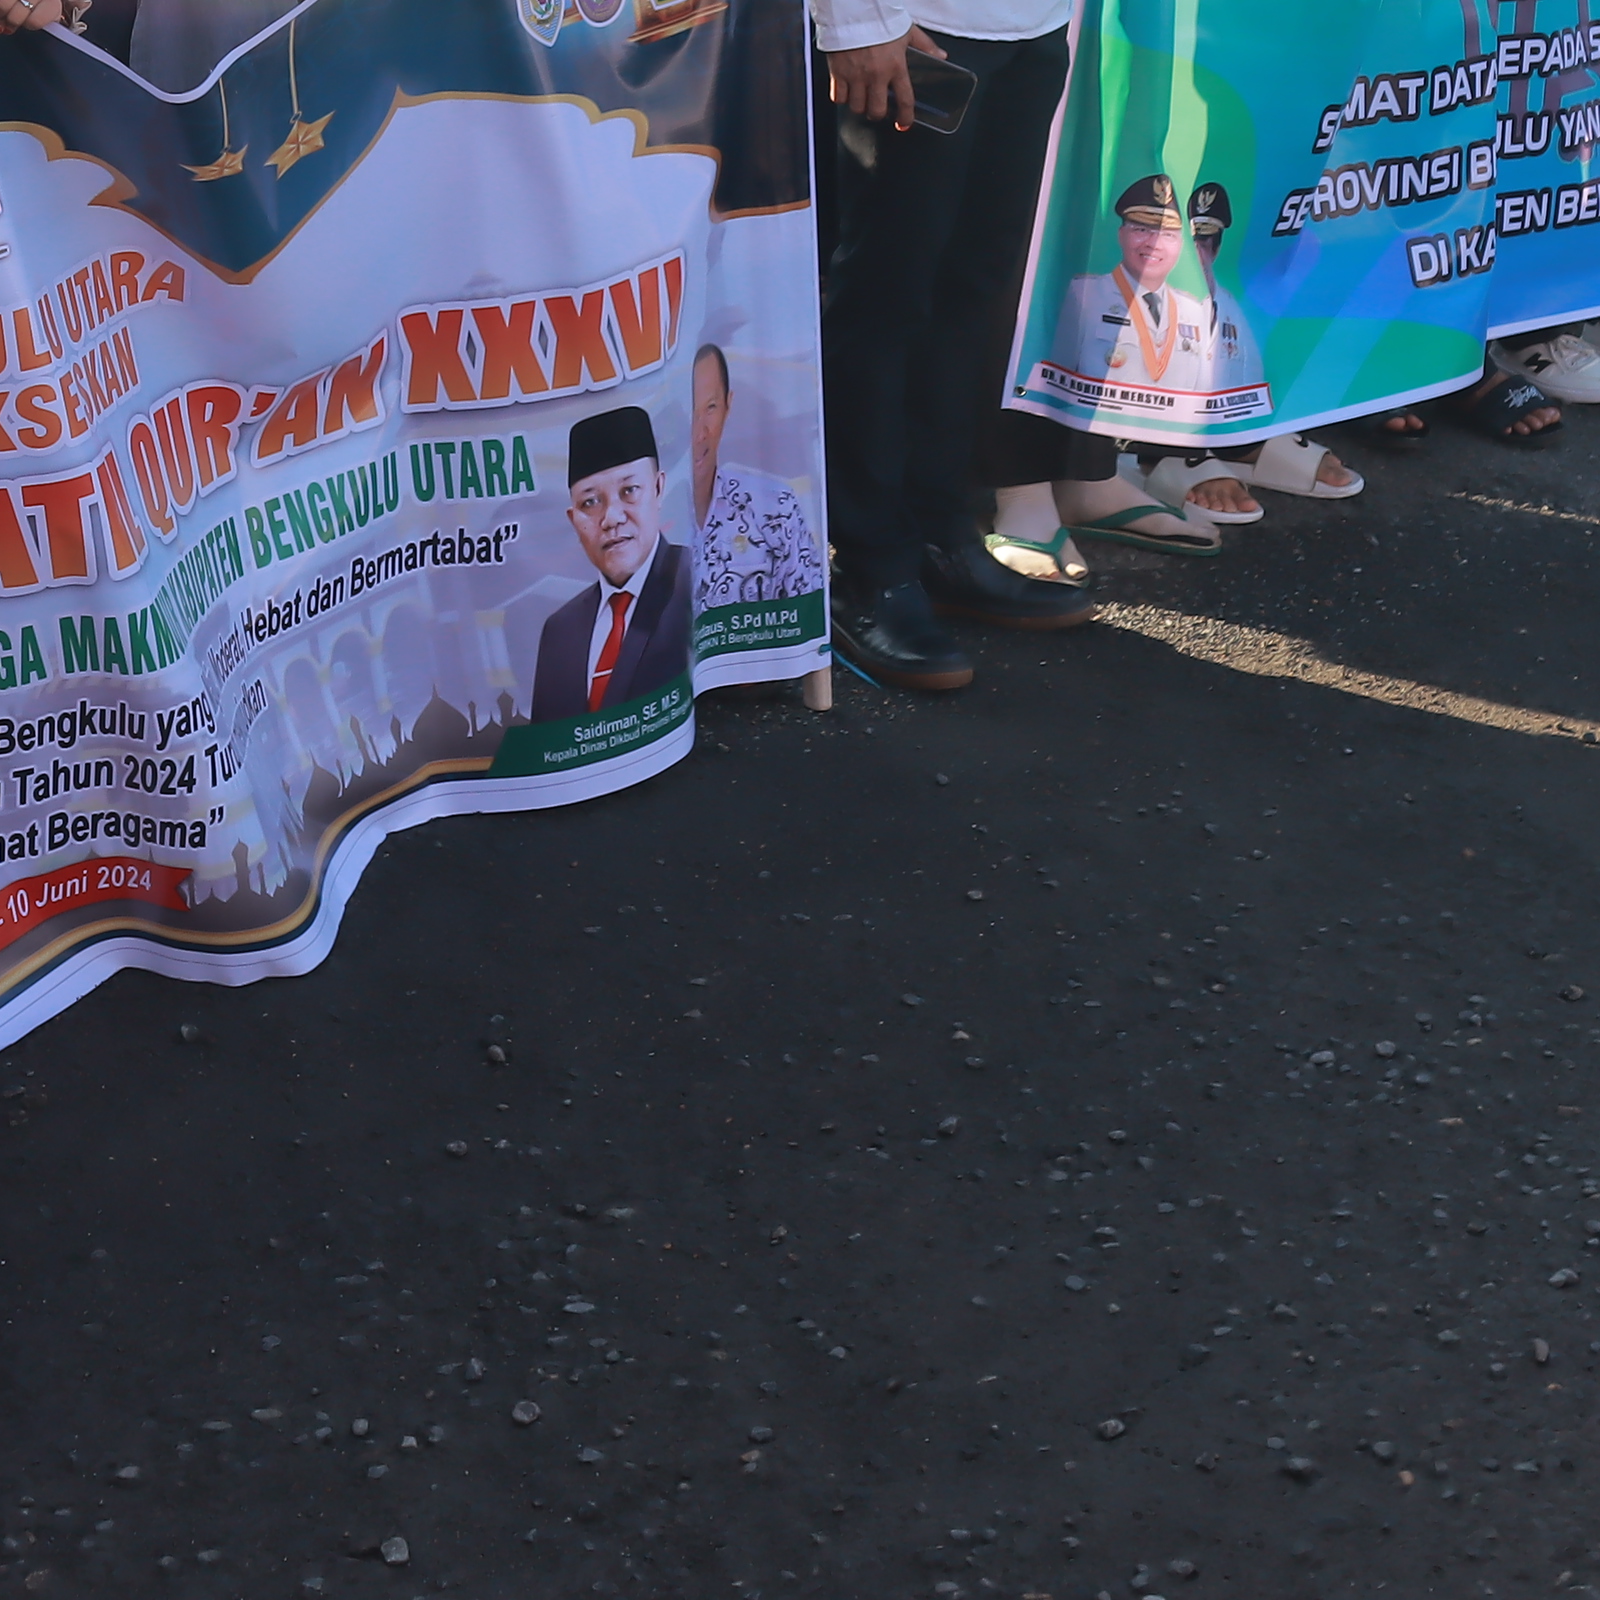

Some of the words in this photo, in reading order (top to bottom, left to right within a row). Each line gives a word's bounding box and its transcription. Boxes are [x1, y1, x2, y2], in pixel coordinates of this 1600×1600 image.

[1410, 234, 1450, 283] DI
[55, 250, 186, 344] UTARA
[131, 334, 385, 536] QUR'AN
[400, 256, 683, 406] XXXVI
[1120, 390, 1175, 408] MERSYAH
[166, 516, 245, 638] KABUPATEN
[245, 450, 400, 570] BENGKULU
[409, 434, 535, 502] UTARA
[720, 635, 726, 646] 2
[728, 630, 774, 645] Bengkulu
[776, 627, 802, 639] Utara
[731, 612, 761, 630] S.Pd
[765, 608, 798, 626] M.Pd
[156, 692, 215, 750] yang
[240, 591, 303, 652] Hebat
[306, 571, 344, 616] dan
[544, 746, 579, 764] Kepala
[580, 739, 608, 756] Dinas
[609, 728, 641, 748] Dikbud
[641, 714, 671, 736] Provinsi
[574, 713, 641, 743] Saidirman,
[12, 758, 114, 806] Tahun
[123, 754, 197, 797] 2024
[7, 888, 30, 924] 10
[35, 869, 89, 908] Juni
[96, 864, 152, 891] 2024
